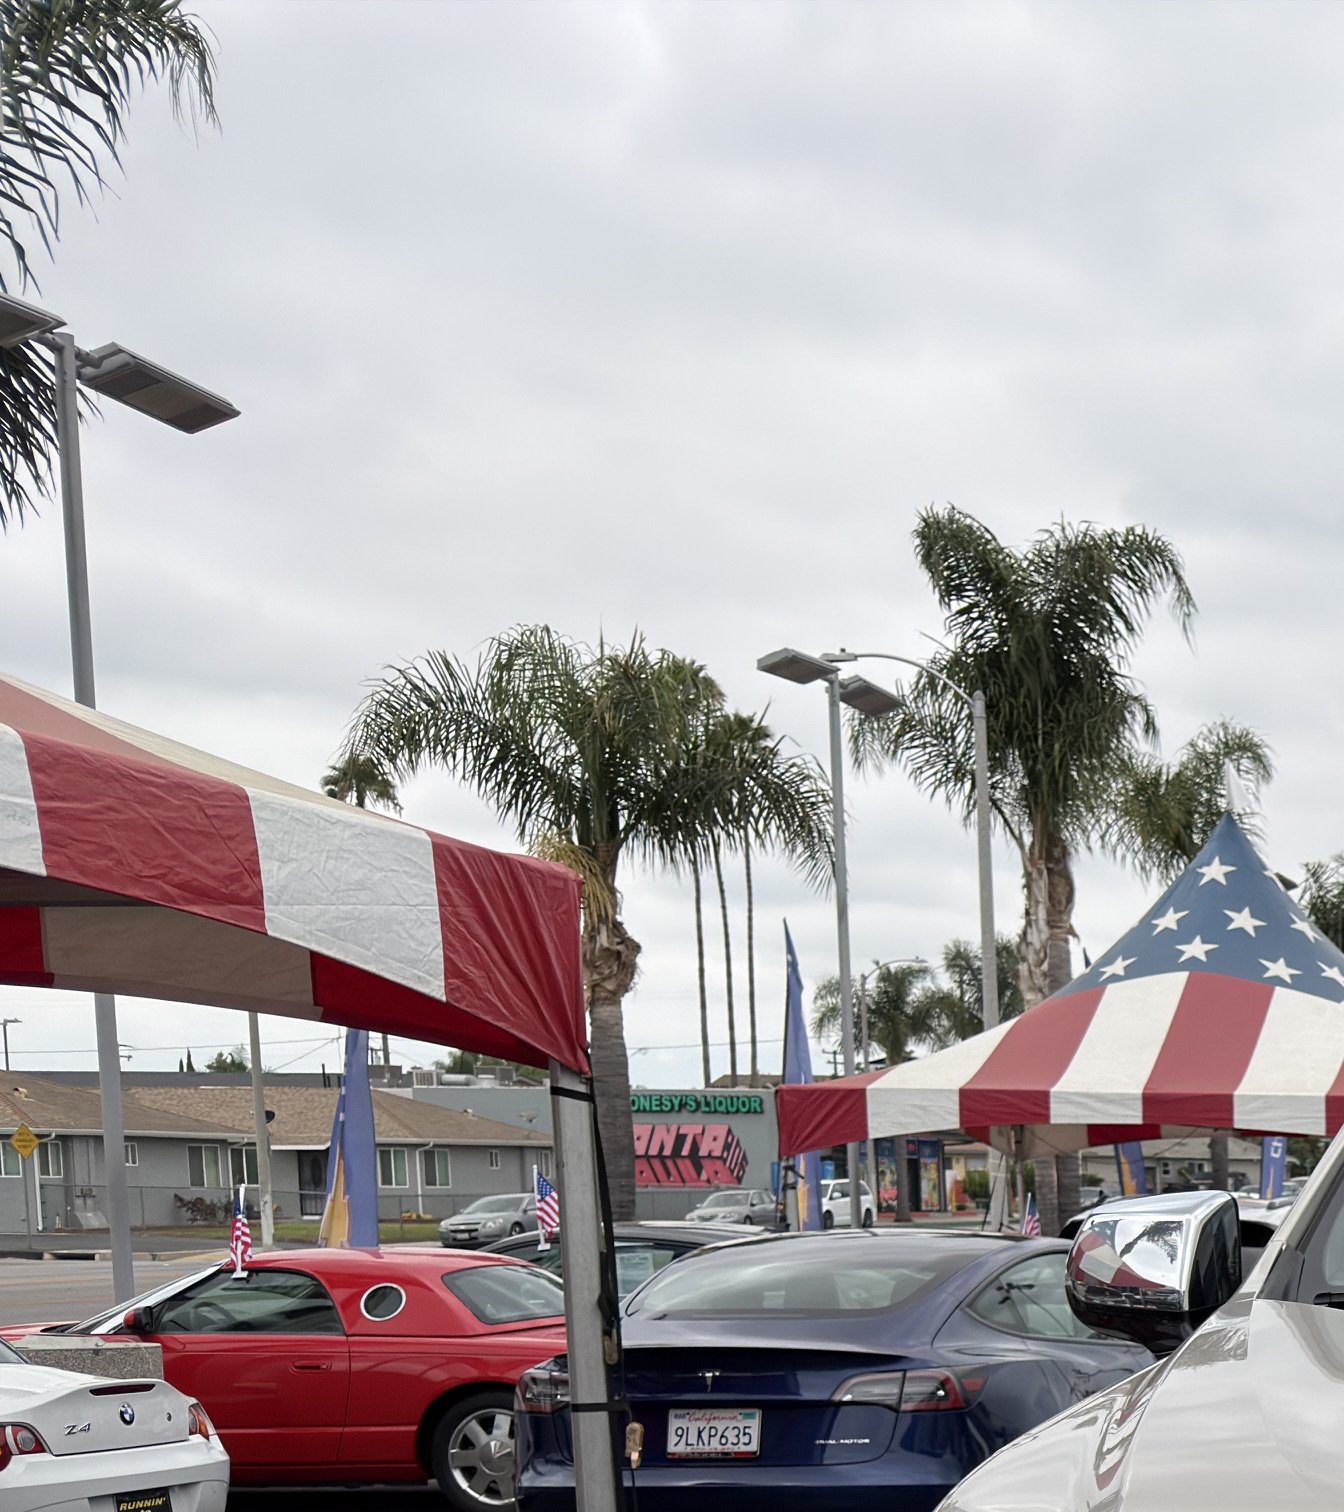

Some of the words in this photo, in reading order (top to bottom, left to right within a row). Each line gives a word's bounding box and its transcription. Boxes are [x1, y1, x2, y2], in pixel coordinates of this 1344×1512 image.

[701, 1094, 764, 1114] LIQUOR
[64, 1422, 91, 1436] Z4
[673, 1425, 753, 1447] 9LKP635
[120, 1497, 167, 1511] RUNNIN'
